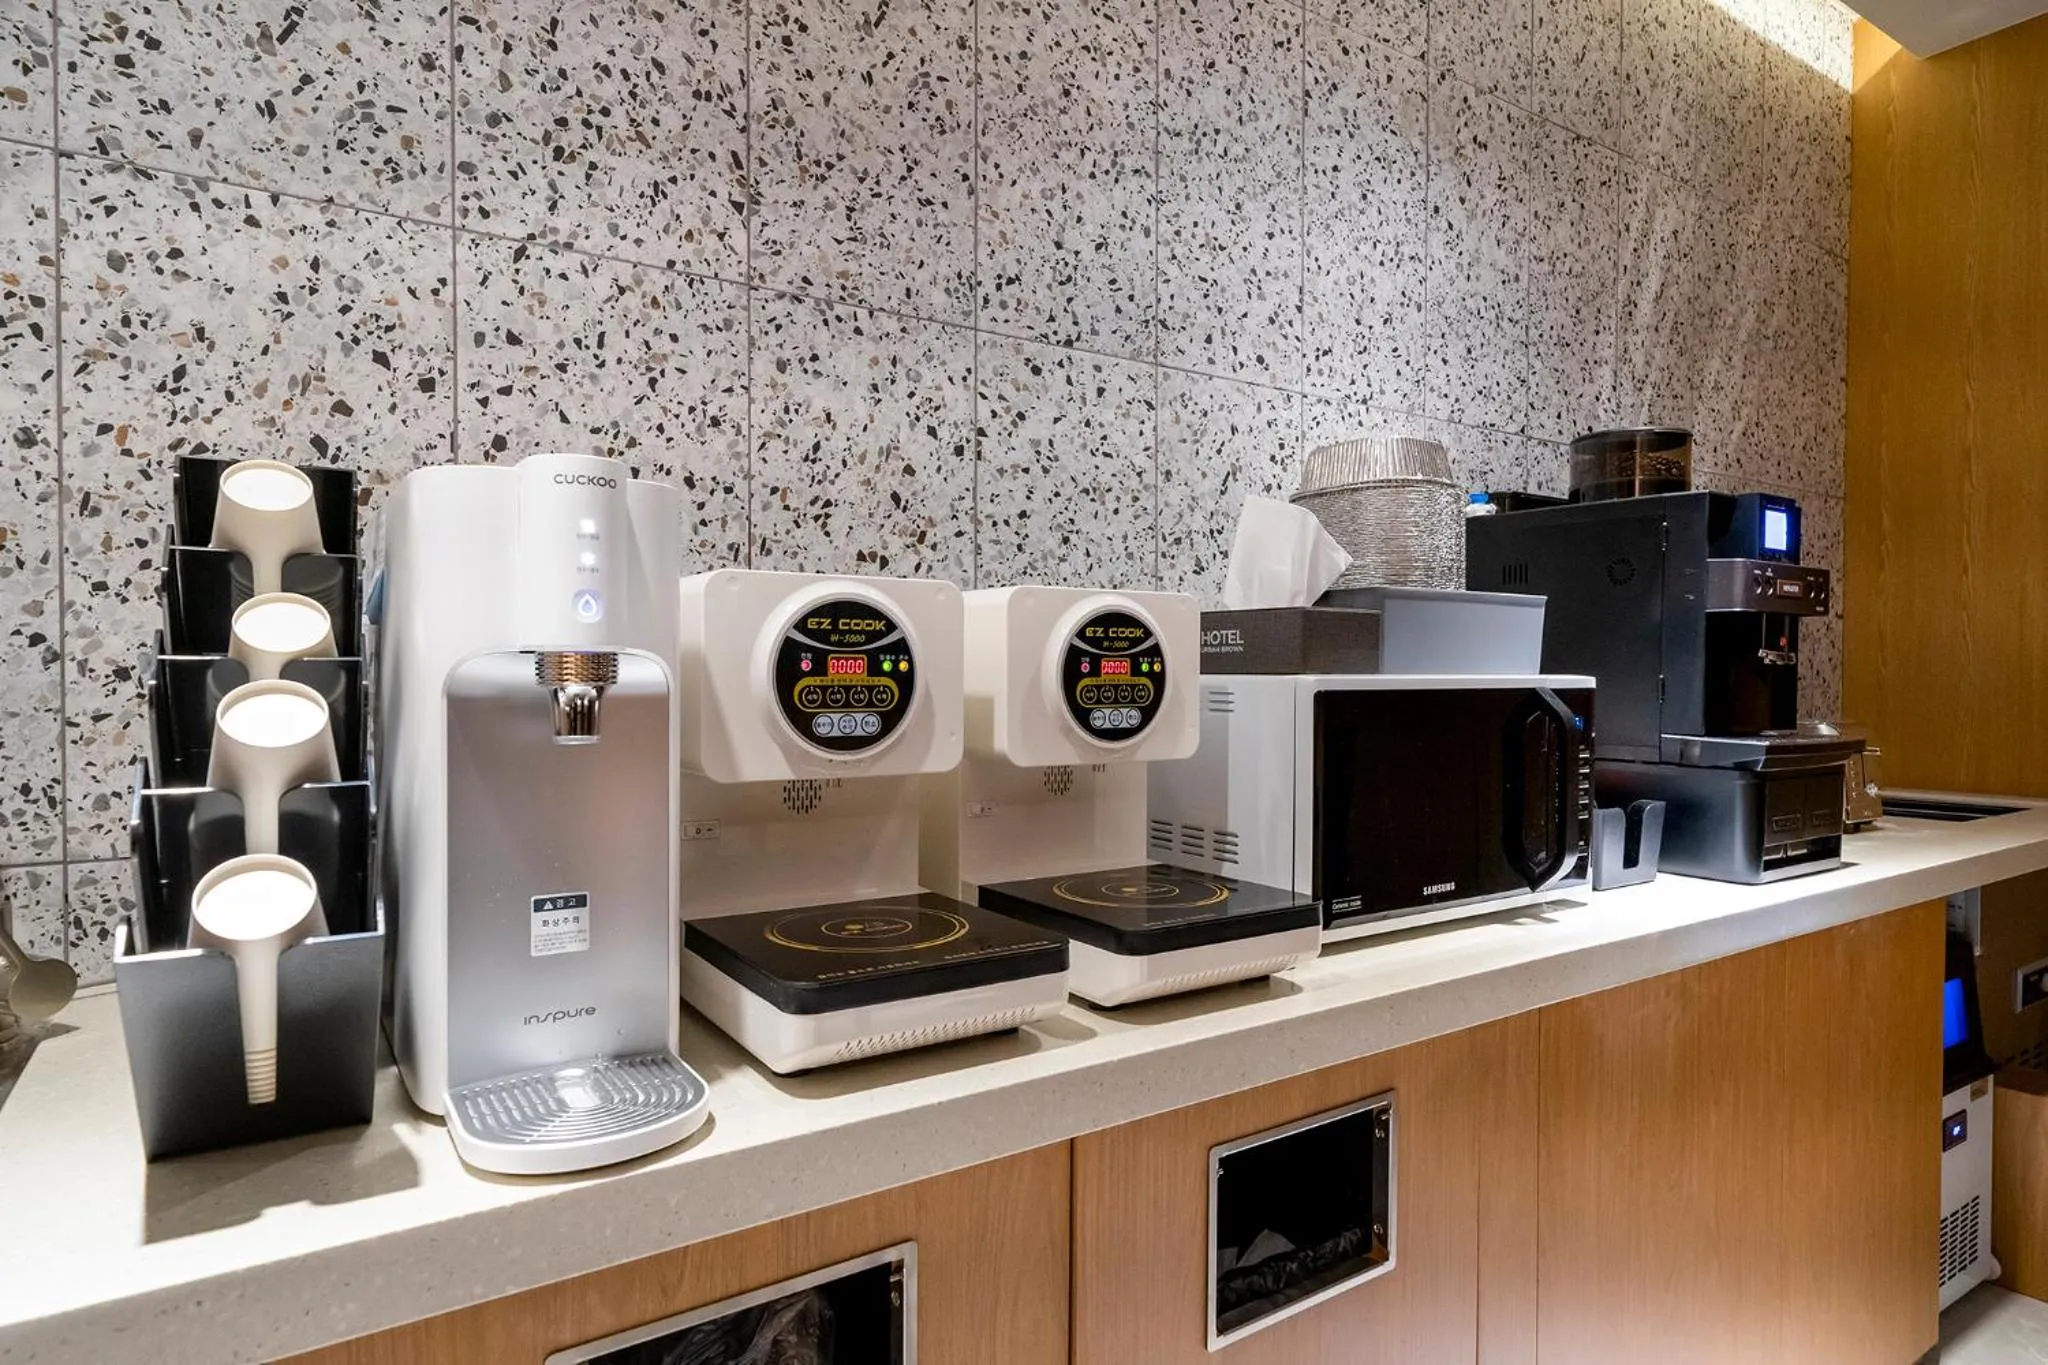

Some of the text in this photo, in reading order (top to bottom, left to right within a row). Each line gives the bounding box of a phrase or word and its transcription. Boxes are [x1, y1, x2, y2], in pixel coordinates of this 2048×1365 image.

[553, 473, 617, 489] CUCKOO
[807, 618, 887, 630] EZ COOK
[1085, 627, 1144, 637] EZ COOK
[1201, 630, 1245, 645] HOTEL
[1423, 882, 1456, 896] SAMSUNG
[523, 1006, 597, 1026] inspure
